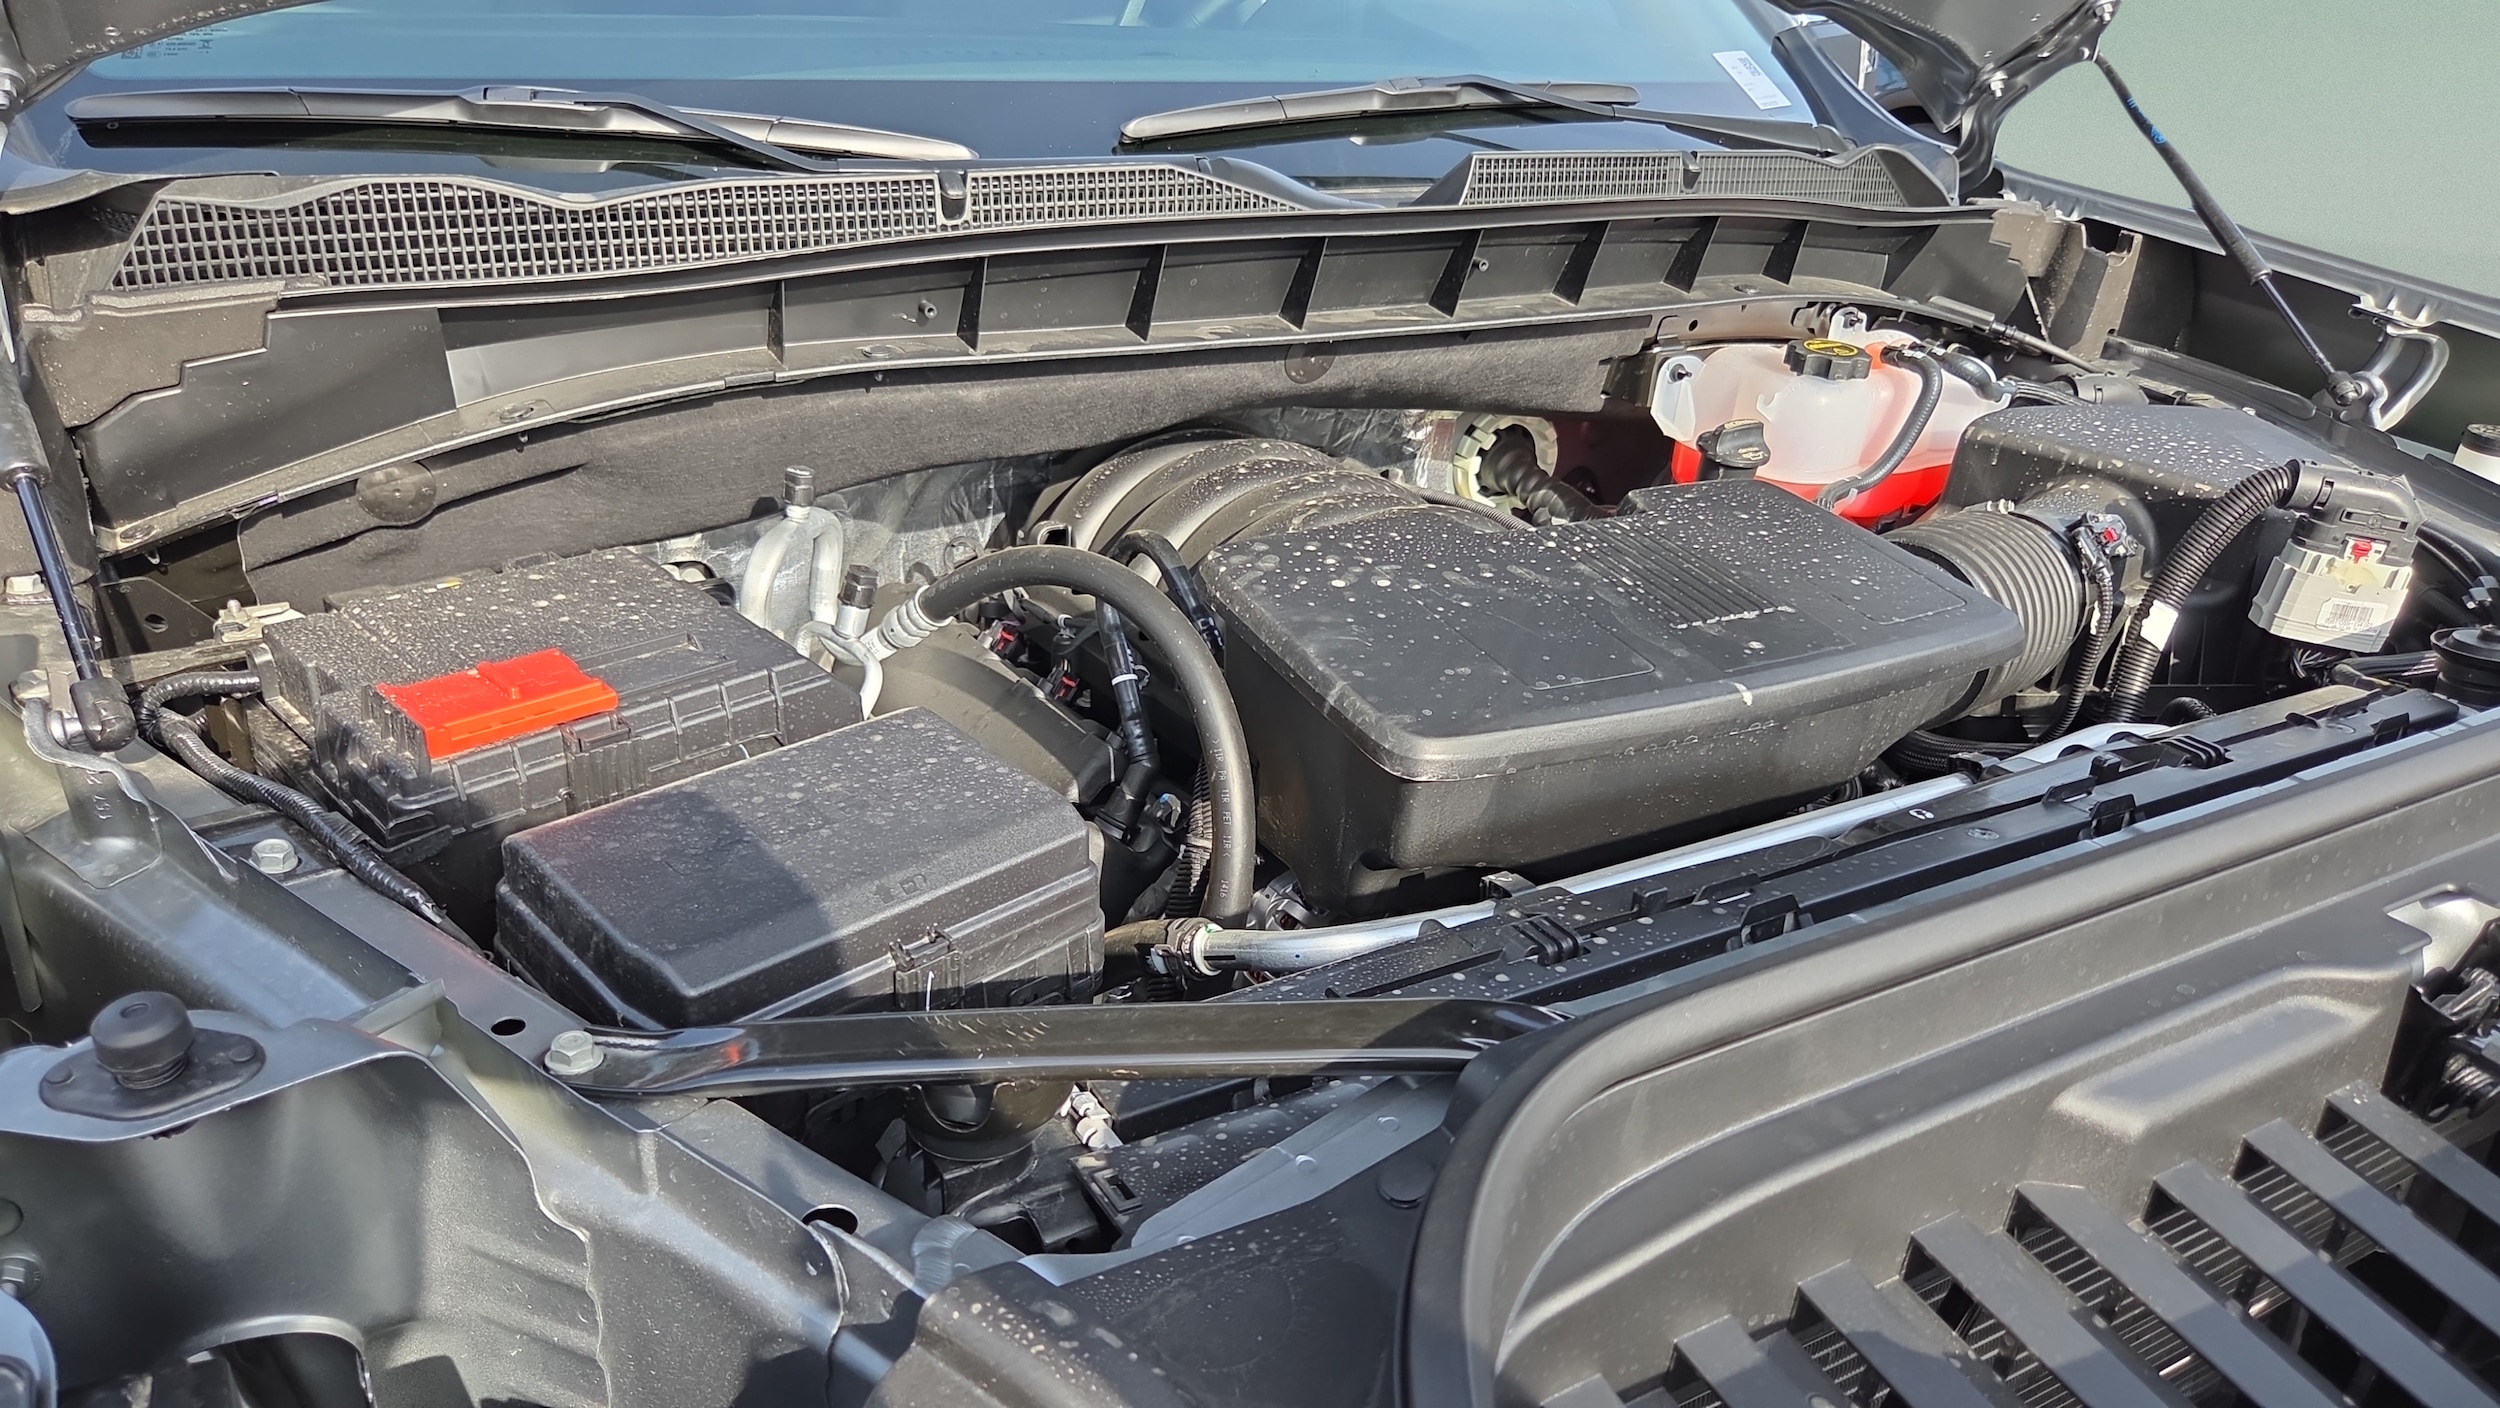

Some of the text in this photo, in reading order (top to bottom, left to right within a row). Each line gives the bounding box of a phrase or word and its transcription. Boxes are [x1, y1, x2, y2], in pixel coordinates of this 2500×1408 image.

[1218, 769, 1228, 781] PA
[1220, 788, 1231, 804] IIR
[1222, 810, 1232, 827] PET
[1219, 878, 1229, 898] 1416
